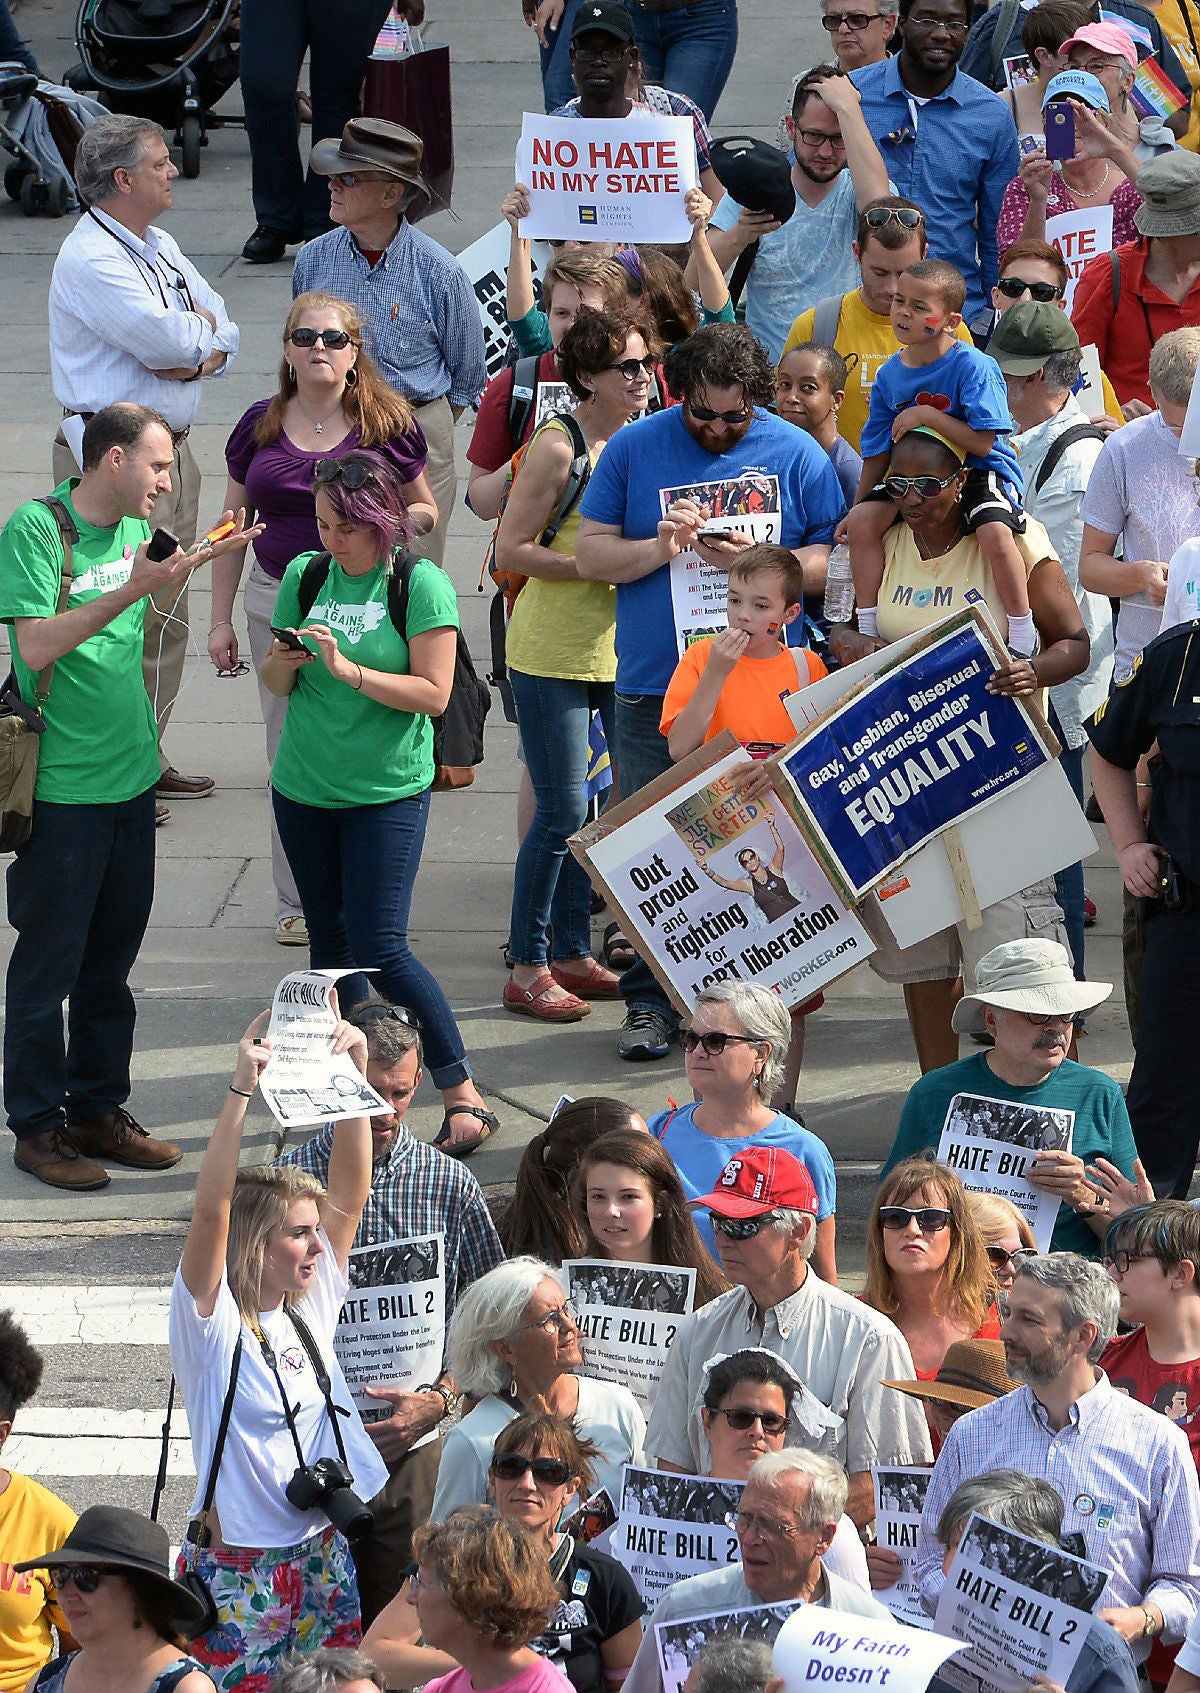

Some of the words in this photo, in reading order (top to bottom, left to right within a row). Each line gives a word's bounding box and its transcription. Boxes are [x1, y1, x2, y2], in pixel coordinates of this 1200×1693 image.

[533, 139, 578, 168] NO
[588, 142, 678, 169] HATE
[532, 171, 556, 191] IN
[563, 173, 599, 192] MY
[607, 174, 680, 194] STATE
[766, 524, 774, 543] 2
[91, 565, 104, 576] NC
[94, 570, 130, 588] AGAINST
[686, 562, 698, 570] ANTI
[702, 584, 712, 592] The
[691, 608, 704, 616] ANTI
[809, 761, 845, 790] Gay,
[842, 710, 910, 762] Lesbian,
[908, 660, 981, 713] Bisexual
[838, 768, 870, 796] and
[868, 694, 970, 770] Transgender
[844, 711, 996, 838] EQUALITY
[971, 766, 1020, 798] www.hrc.org
[671, 801, 697, 826] WE
[707, 777, 734, 804] ARE
[683, 814, 713, 842] JUST
[630, 853, 672, 892] Out
[638, 867, 700, 926] proud
[661, 908, 688, 934] and
[664, 902, 750, 965] fighting
[740, 902, 841, 977] liberation
[705, 944, 728, 967] for
[771, 936, 858, 995] TWORKER.org
[278, 980, 300, 1004] HATE
[301, 983, 320, 1007] BILL
[947, 1143, 994, 1173] HATE
[722, 1160, 742, 1186] S
[964, 1182, 986, 1192] Access
[986, 1186, 992, 1194] to
[993, 1186, 1008, 1196] State
[1010, 1189, 1026, 1198] Court
[1027, 1191, 1037, 1200] for
[339, 1298, 370, 1325] ATE
[378, 1295, 418, 1321] BILL
[424, 1290, 434, 1314] 2
[342, 1334, 358, 1344] Equal
[360, 1332, 390, 1342] Protection
[392, 1330, 409, 1340] Under
[410, 1328, 420, 1336] the
[420, 1326, 430, 1334] Law
[618, 1319, 658, 1347] BILL
[664, 1324, 677, 1348] 2
[344, 1348, 361, 1360] Living
[362, 1346, 382, 1358] Wages
[383, 1345, 394, 1354] and
[396, 1344, 414, 1353] Worker
[416, 1339, 436, 1350] Benefits
[582, 1347, 596, 1356] Equal
[598, 1349, 626, 1362] Protection
[628, 1354, 644, 1364] Under
[646, 1358, 656, 1366] the
[344, 1363, 386, 1375] Employment
[386, 1362, 394, 1370] and
[345, 1375, 358, 1384] Civil
[360, 1374, 378, 1383] Rights
[380, 1370, 412, 1380] Protections
[583, 1360, 600, 1370] Living
[600, 1364, 617, 1374] Wages
[618, 1368, 628, 1376] and
[630, 1369, 648, 1380] Worker
[618, 1380, 628, 1388] and
[626, 1524, 668, 1556] HATE
[676, 1532, 718, 1562] BILL
[726, 1538, 738, 1562] 2
[888, 1522, 920, 1548] HAT
[630, 1565, 644, 1576] ANTI
[644, 1567, 666, 1578] Access
[667, 1569, 674, 1578] to
[896, 1584, 909, 1592] ANTI
[908, 1596, 920, 1604] and
[956, 1568, 1007, 1612] HATE
[1008, 1596, 1054, 1636] BILL
[1058, 1620, 1078, 1646] 2
[812, 1630, 848, 1654] My
[852, 1636, 911, 1658] Faith
[956, 1604, 970, 1616] ANTI
[971, 1610, 992, 1628] Access
[992, 1623, 1000, 1632] to
[1000, 1628, 1018, 1644] State
[1018, 1638, 1036, 1652] Court
[1036, 1648, 1048, 1659] for
[968, 1622, 1002, 1648] Employment
[1003, 1642, 1049, 1672] Discrimination
[976, 1641, 996, 1657] Values
[996, 1655, 1002, 1663] of
[805, 1658, 892, 1686] Doesn't
